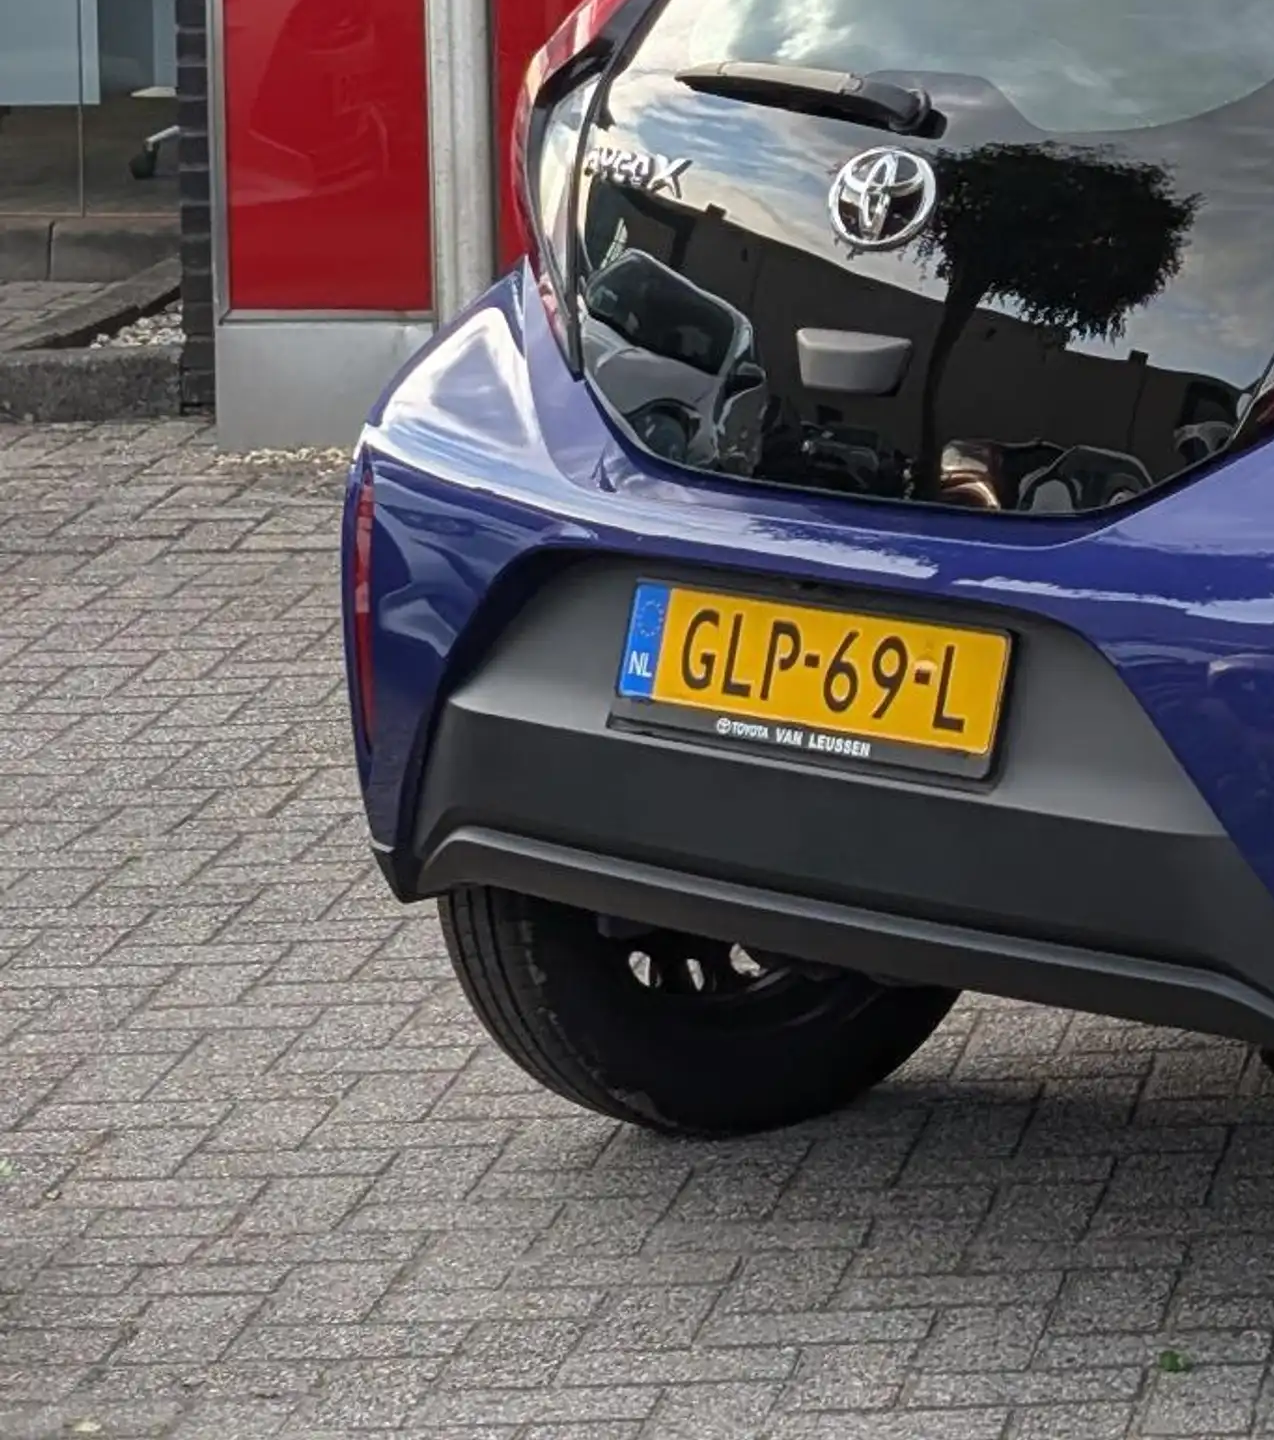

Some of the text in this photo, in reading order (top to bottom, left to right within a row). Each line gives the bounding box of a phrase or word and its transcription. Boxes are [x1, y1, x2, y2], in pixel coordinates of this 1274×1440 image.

[628, 650, 652, 677] NL
[681, 608, 965, 733] GLP-69-L
[731, 721, 871, 757] TOYOTA VAN LEUSSEN
